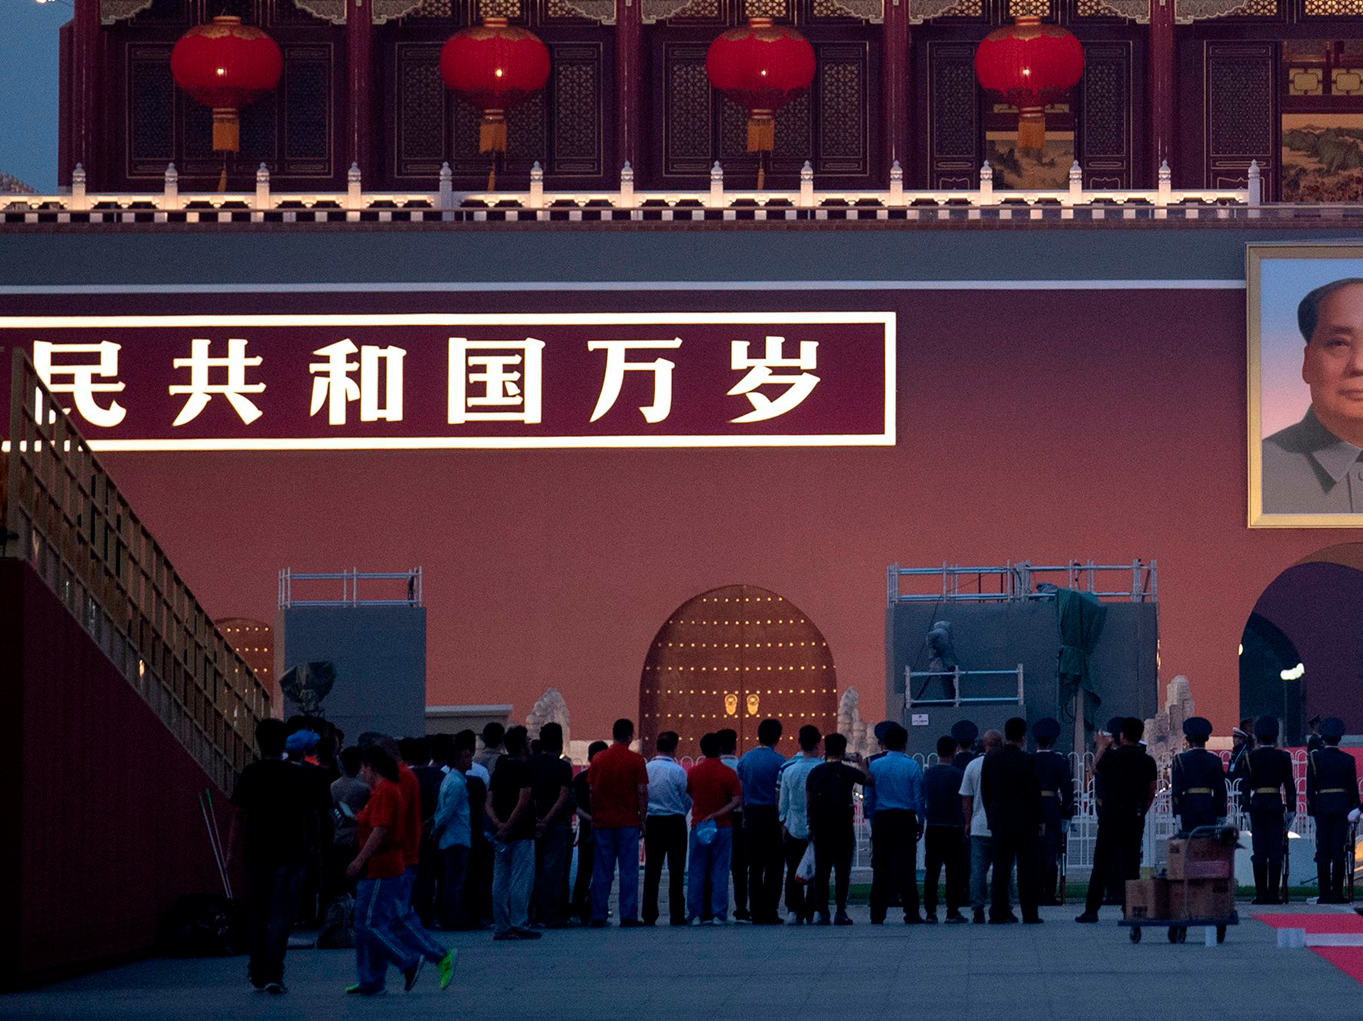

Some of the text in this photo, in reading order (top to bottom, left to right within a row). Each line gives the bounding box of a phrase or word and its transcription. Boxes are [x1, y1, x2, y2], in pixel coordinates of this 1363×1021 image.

[33, 335, 821, 427] 民共和国万岁
